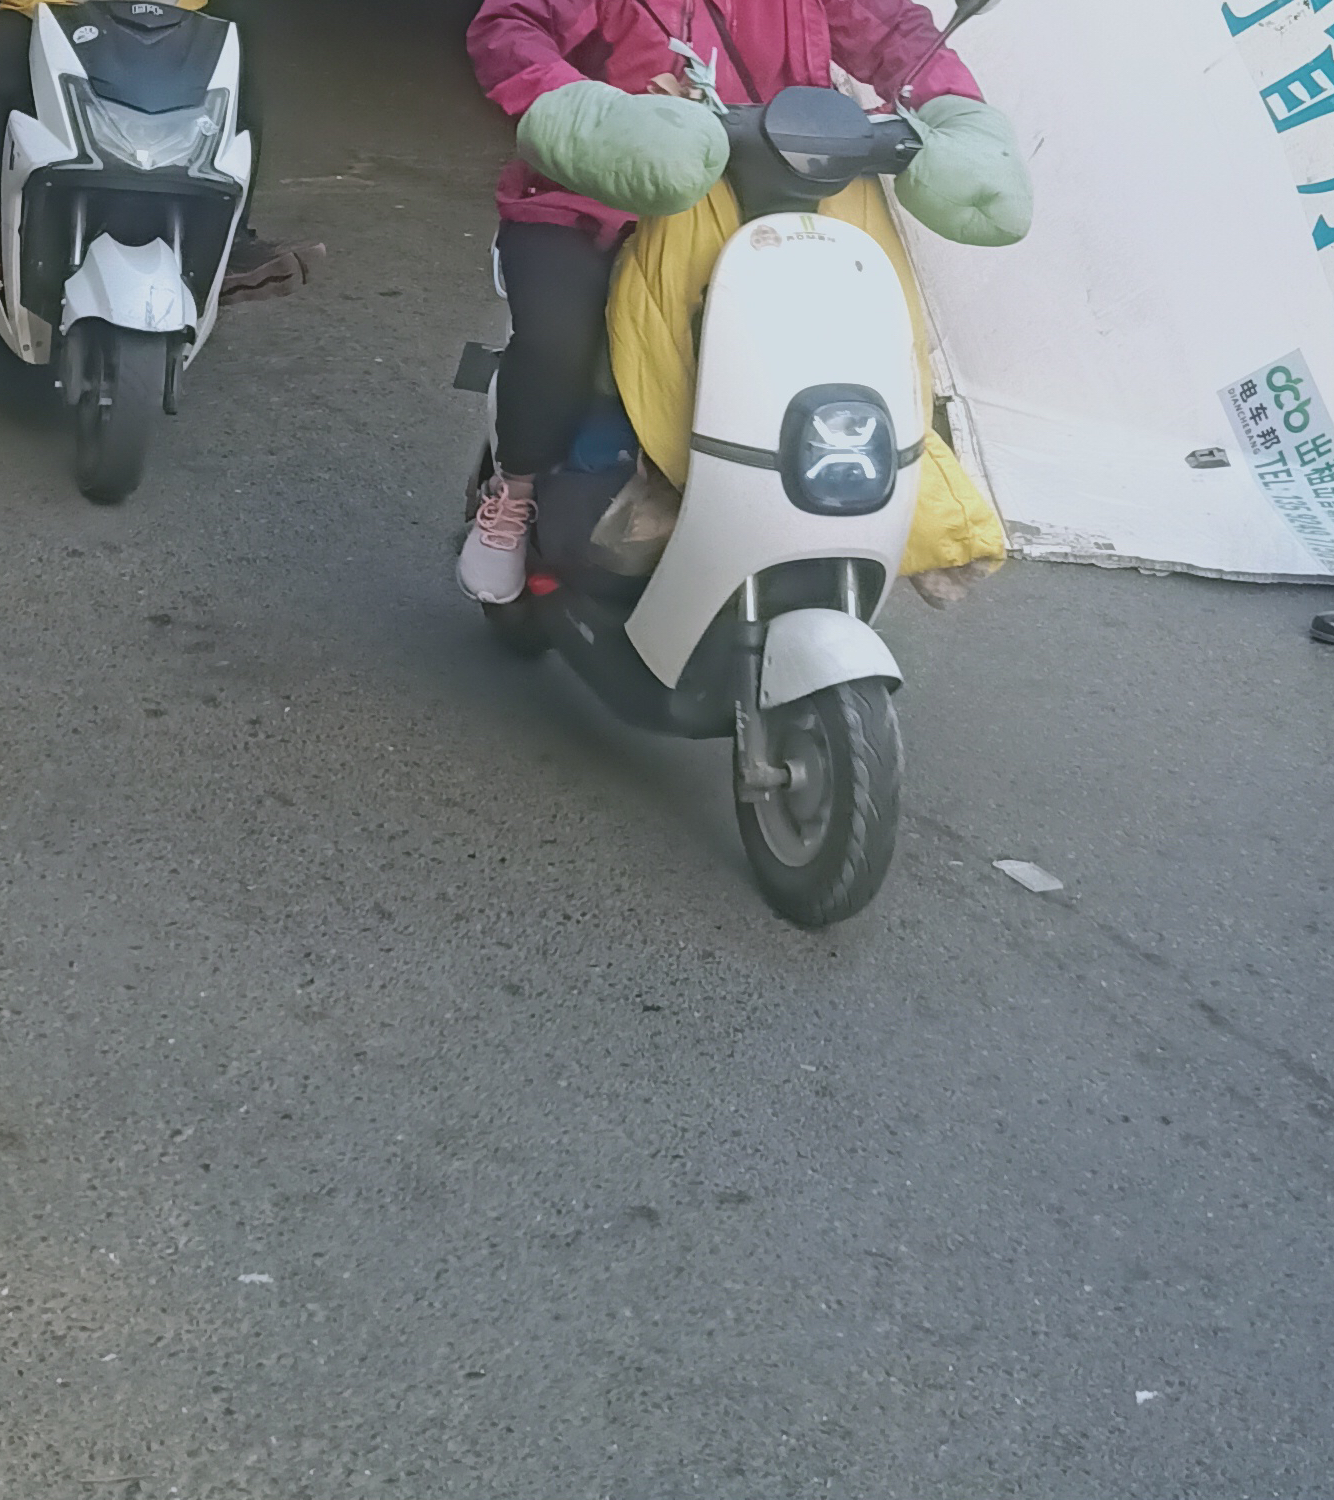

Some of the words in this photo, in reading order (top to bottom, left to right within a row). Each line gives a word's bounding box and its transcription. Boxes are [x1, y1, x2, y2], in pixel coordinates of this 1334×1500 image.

[1227, 387, 1262, 456] DIANCHEBANG
[1239, 378, 1282, 450] 电车邦
